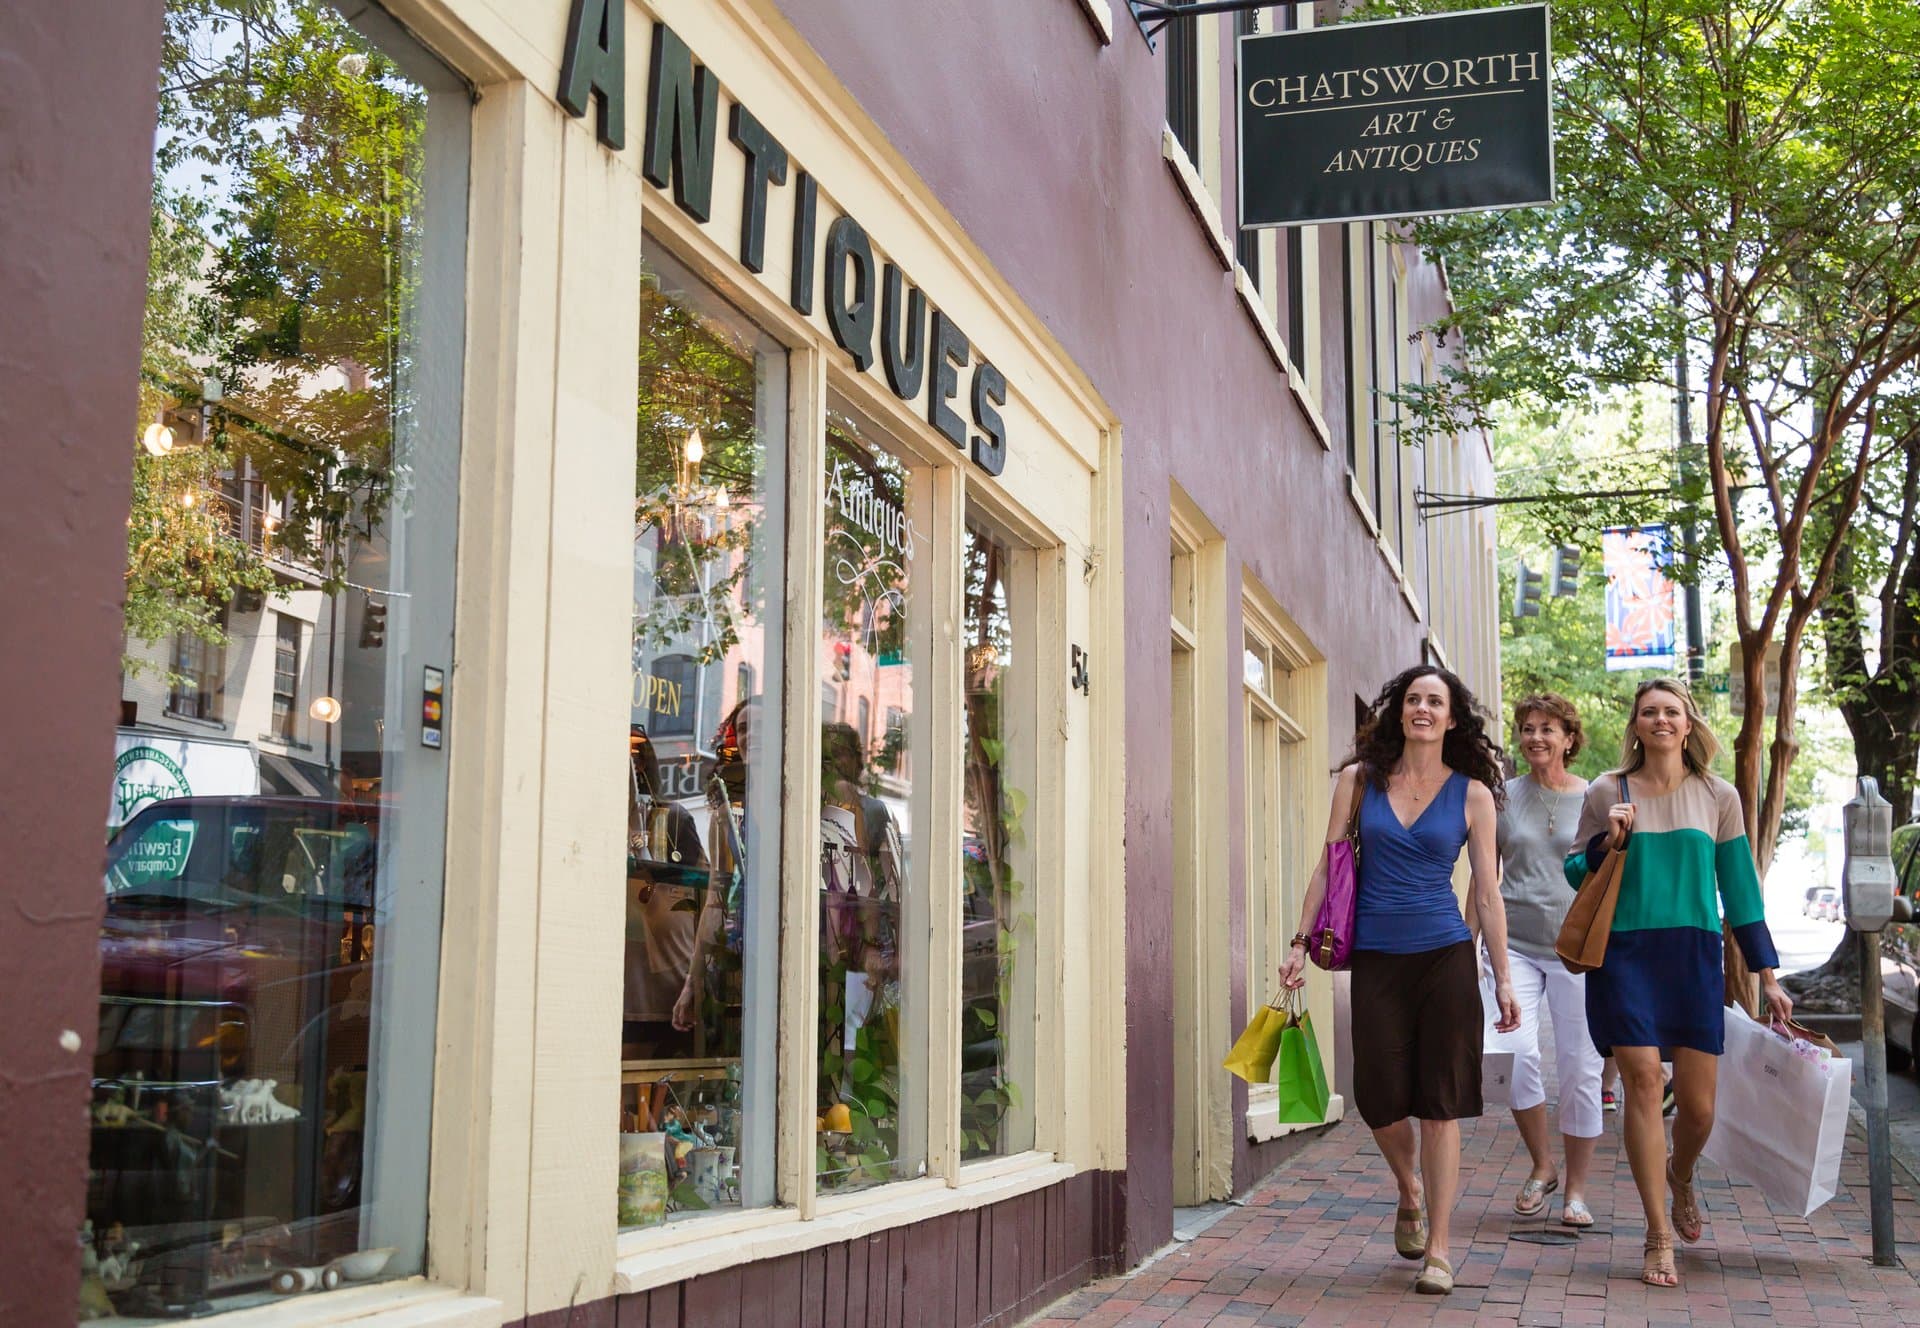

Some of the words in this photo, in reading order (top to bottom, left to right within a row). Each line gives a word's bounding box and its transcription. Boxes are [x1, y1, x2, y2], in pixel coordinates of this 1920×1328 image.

[1248, 51, 1540, 107] CHATSWORTH
[1360, 108, 1427, 137] ART
[1432, 108, 1455, 131] &
[1323, 138, 1481, 173] ANTIQUES
[557, 0, 1006, 476] ANTIQUES
[824, 456, 915, 561] Antiques
[631, 671, 682, 718] OPEN
[1071, 643, 1089, 697] 54
